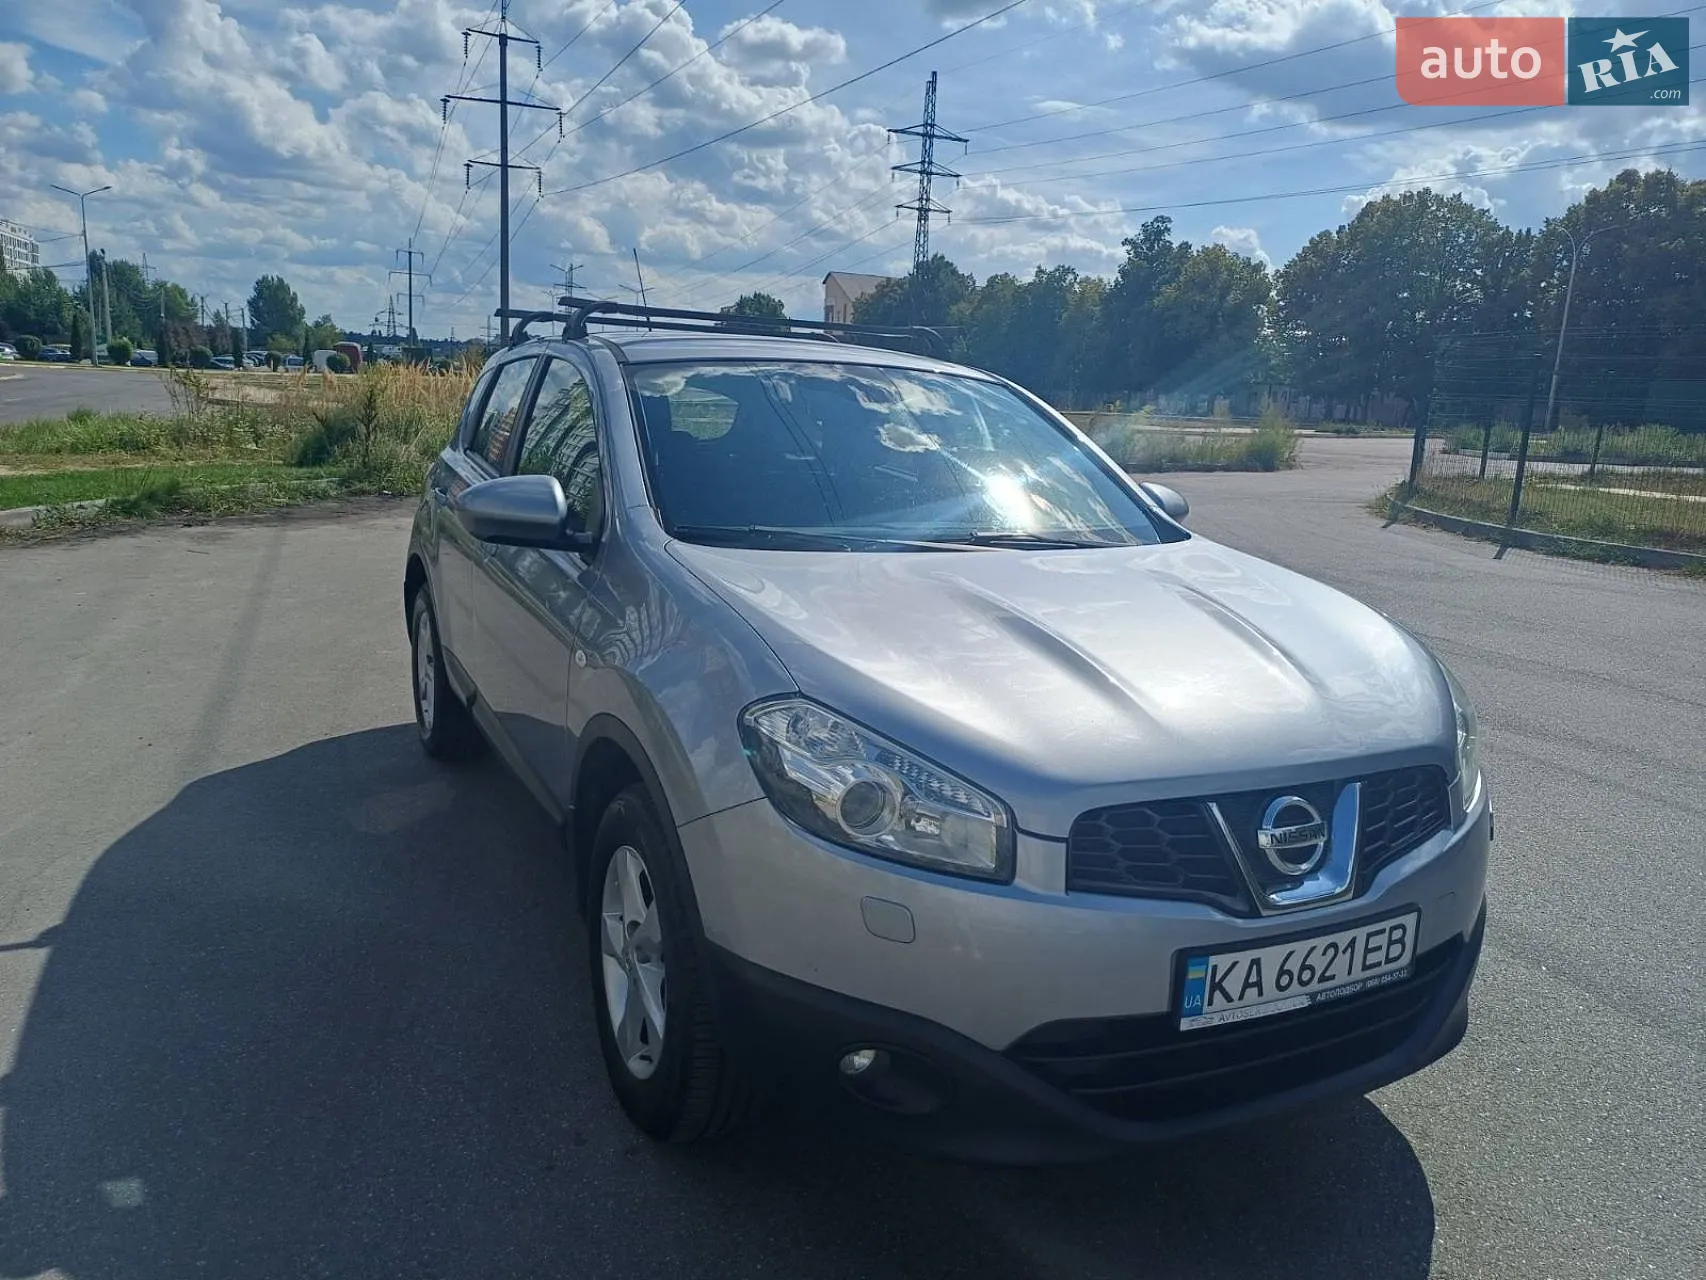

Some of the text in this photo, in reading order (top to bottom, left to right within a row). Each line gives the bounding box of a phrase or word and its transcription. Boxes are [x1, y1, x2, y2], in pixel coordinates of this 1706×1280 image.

[1269, 824, 1325, 845] NISSAN
[1207, 923, 1407, 1007] KA 6621 EB
[1184, 994, 1201, 1009] UA
